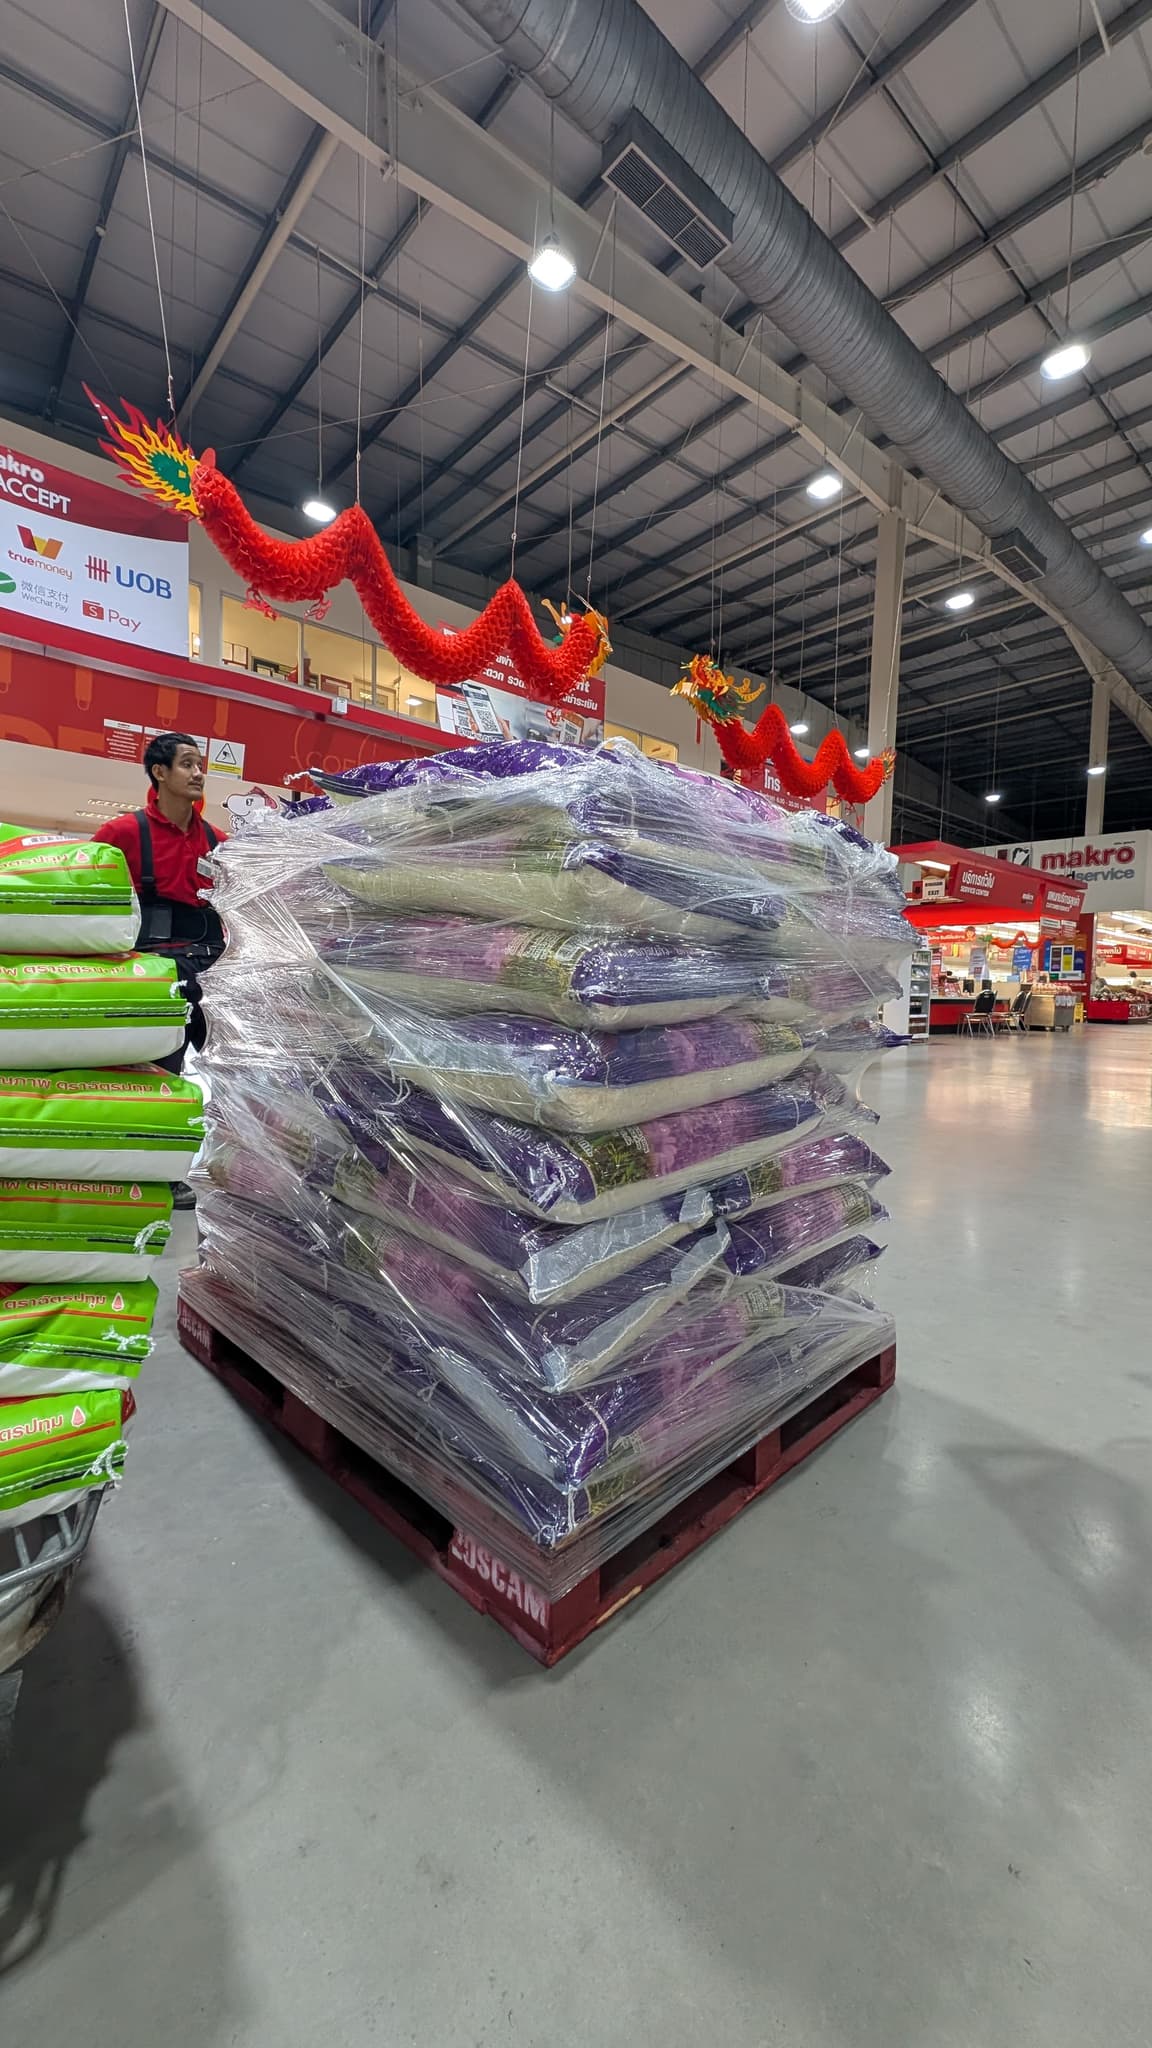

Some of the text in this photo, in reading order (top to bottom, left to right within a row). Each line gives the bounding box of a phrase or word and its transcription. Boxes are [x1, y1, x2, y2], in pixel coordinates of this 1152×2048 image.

[0, 453, 45, 483] akro
[8, 549, 73, 580] truemoney
[20, 579, 69, 603] 微信支付
[115, 565, 172, 600] UOB
[21, 591, 69, 614] WeChat Pay
[108, 608, 141, 633] Pay
[1040, 844, 1136, 871] makro
[1066, 866, 1136, 883] dservice
[0, 1414, 64, 1441] ตรปทุม
